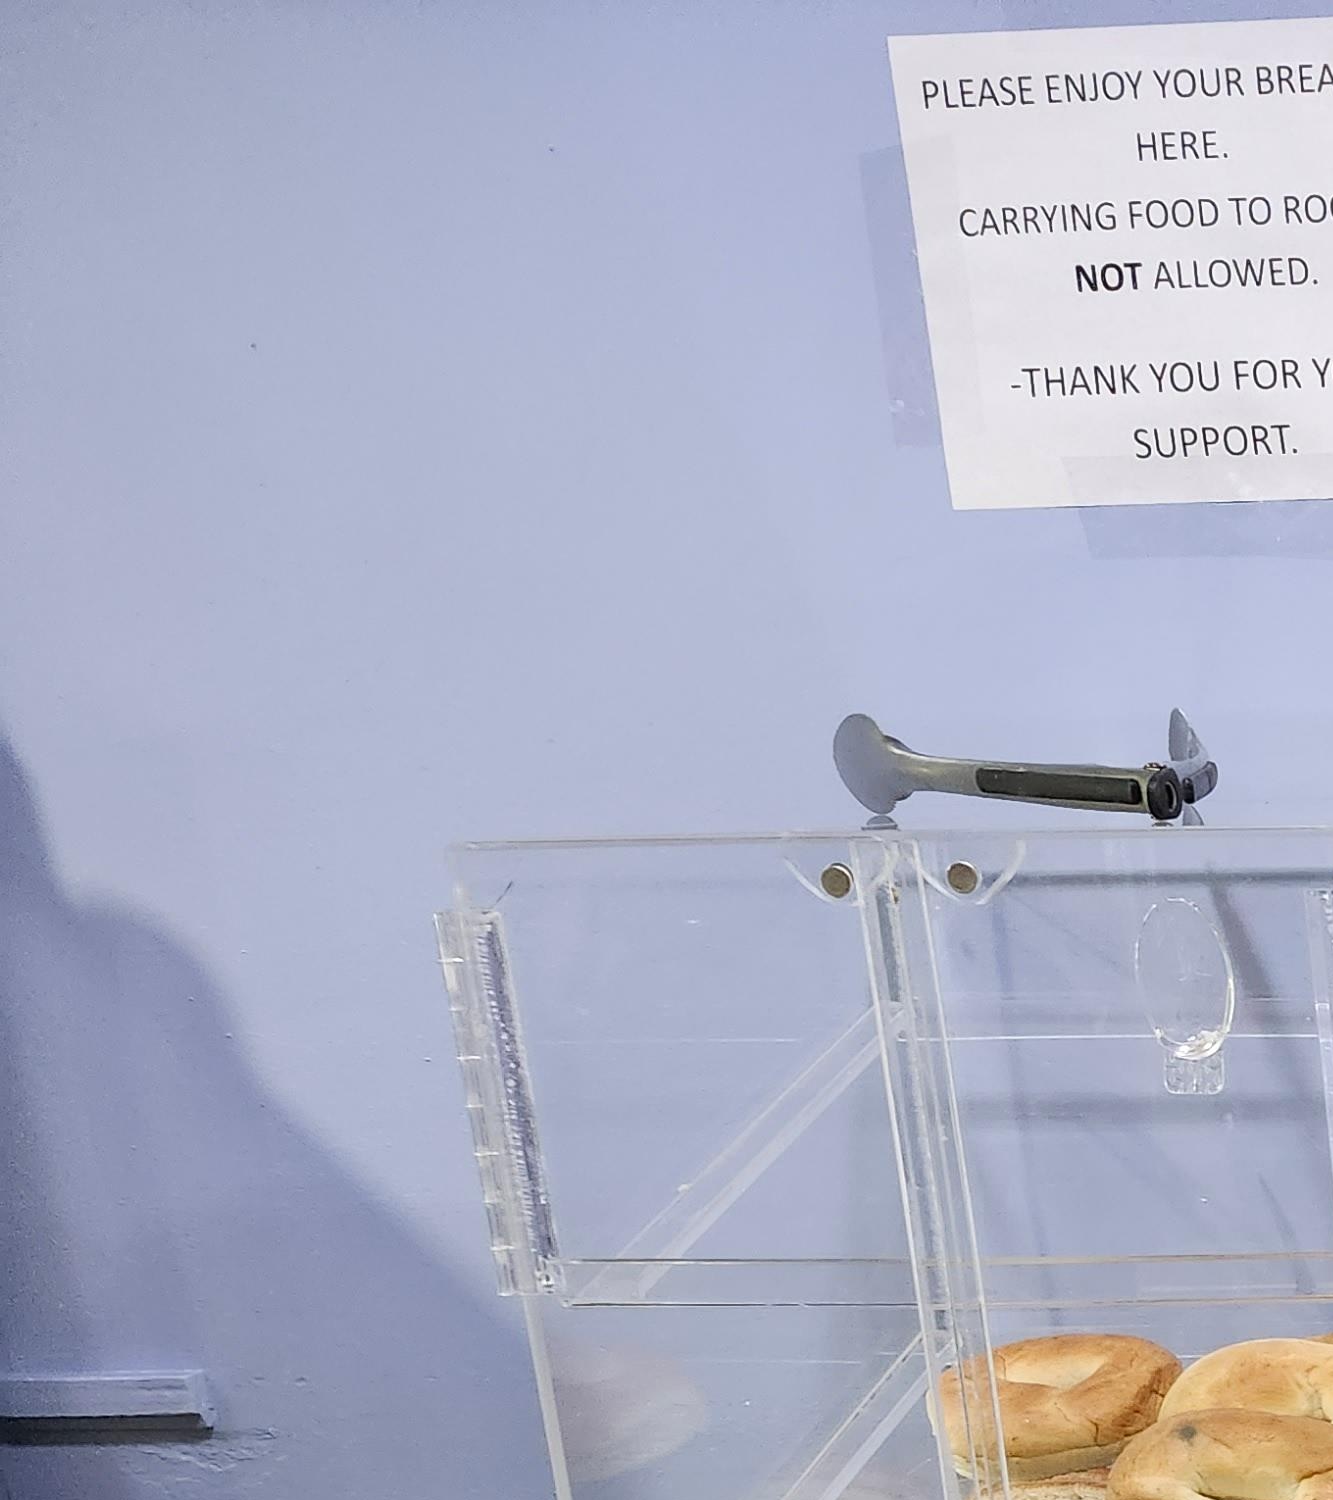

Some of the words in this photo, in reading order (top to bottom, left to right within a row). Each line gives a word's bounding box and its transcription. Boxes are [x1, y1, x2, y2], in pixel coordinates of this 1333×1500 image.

[921, 75, 1035, 110] PLEASE
[1045, 70, 1142, 104] ENJOY
[1153, 67, 1245, 99] YOUR
[1136, 130, 1229, 162] HERE.
[959, 201, 1117, 237] CARRYING
[1128, 197, 1219, 229] FOOD
[1228, 196, 1272, 226] TO
[1074, 262, 1143, 293] NOT
[1154, 257, 1318, 290] ALLOWED.
[1011, 364, 1140, 398] -THANK
[1148, 360, 1220, 393] YOU
[1233, 358, 1302, 391] FOR
[1133, 424, 1298, 460] SUPPORT.
